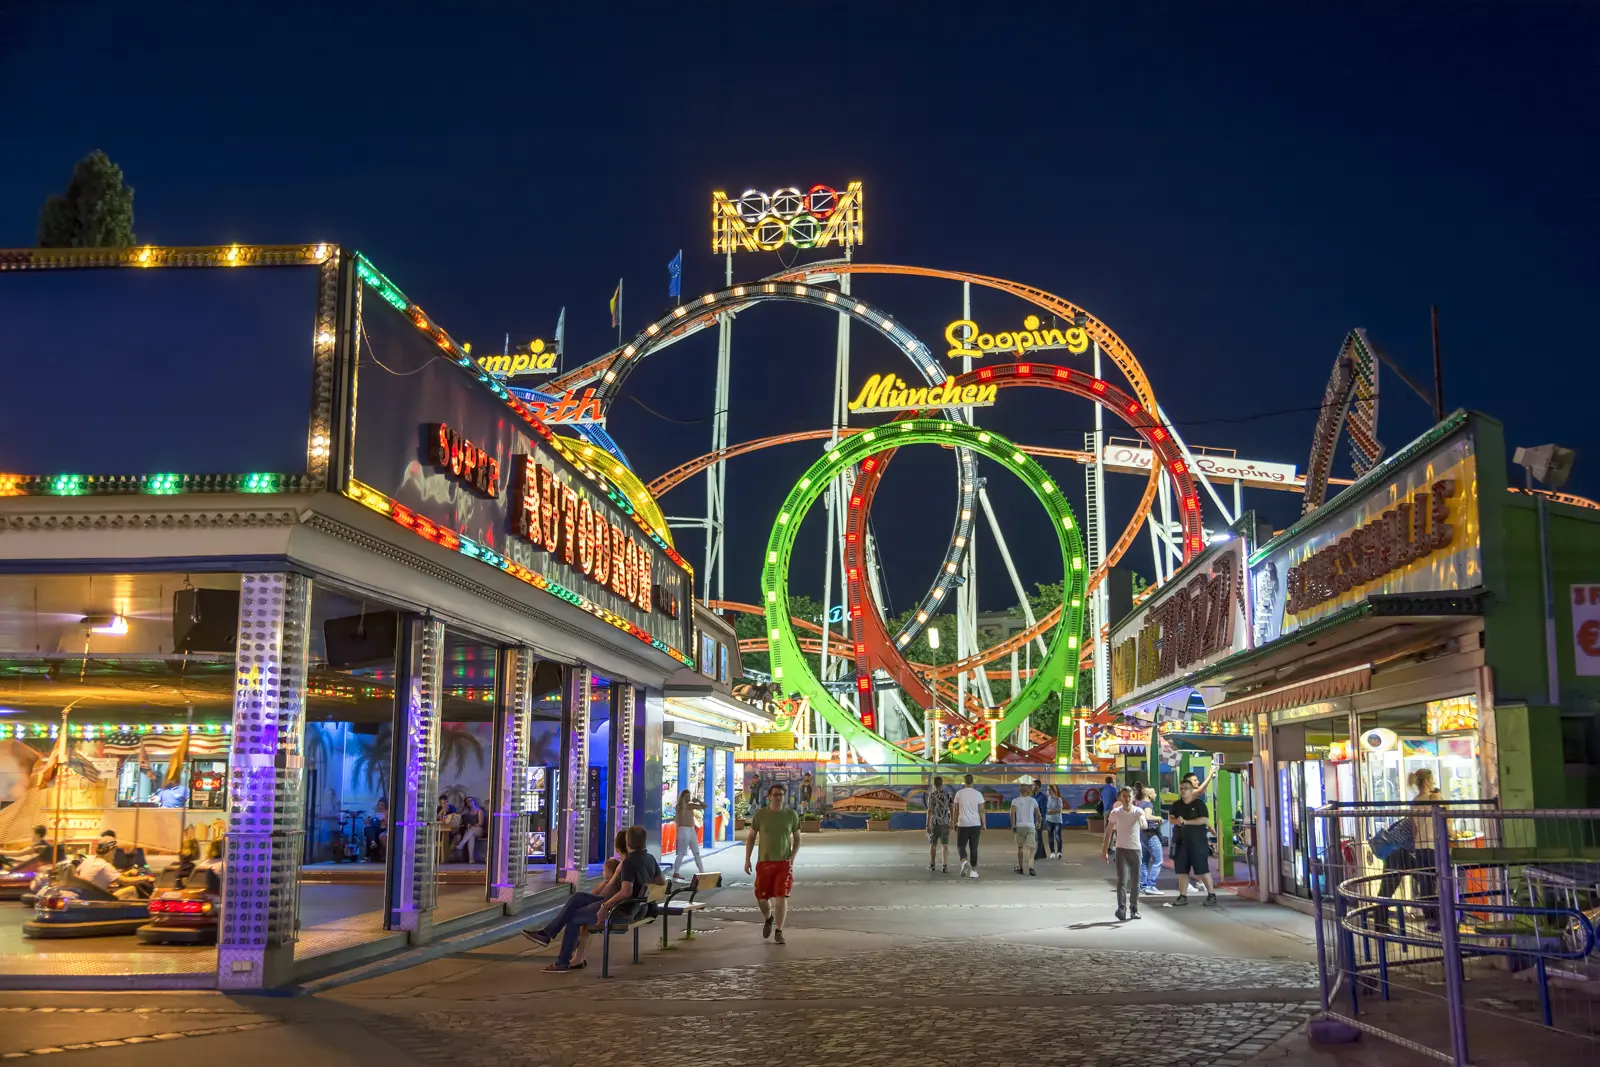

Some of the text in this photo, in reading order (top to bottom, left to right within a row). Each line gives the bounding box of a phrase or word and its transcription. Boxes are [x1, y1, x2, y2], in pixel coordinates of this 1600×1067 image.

[945, 315, 1088, 358] Looping
[848, 373, 997, 410] München
[437, 422, 499, 497] SUPER
[1196, 459, 1285, 482] Looping
[520, 454, 651, 614] AUTODROM
[195, 778, 221, 790] OPEN
